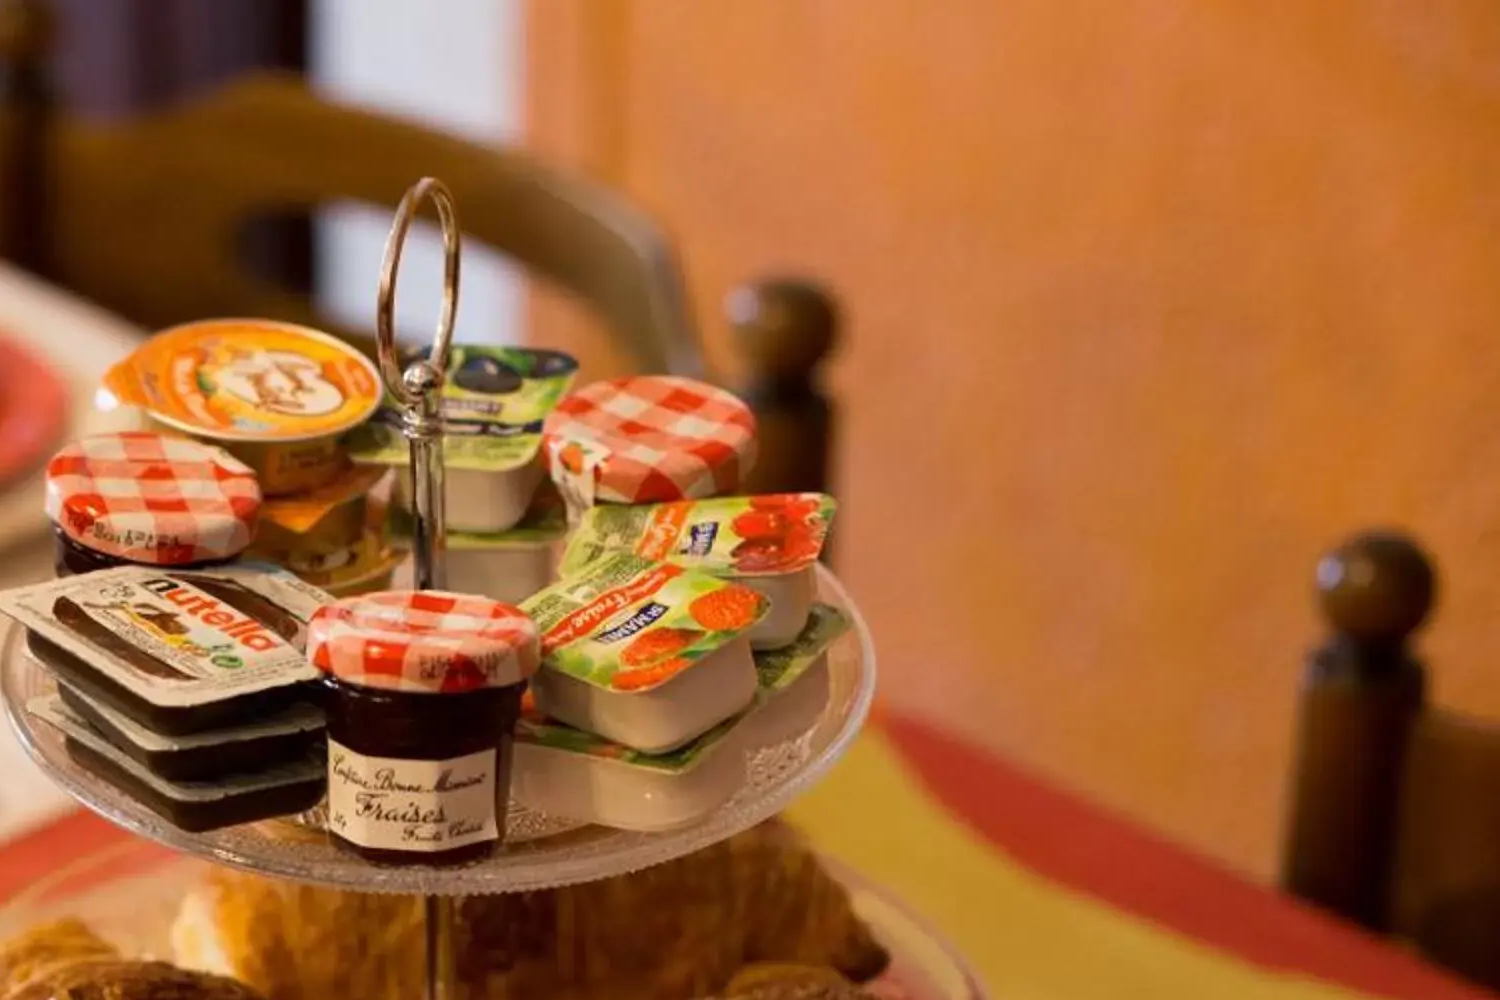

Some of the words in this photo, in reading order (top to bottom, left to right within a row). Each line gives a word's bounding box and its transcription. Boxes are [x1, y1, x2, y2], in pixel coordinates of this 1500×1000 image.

[141, 578, 279, 652] nutella
[373, 766, 423, 793] Bonne
[354, 792, 446, 823] Fraises
